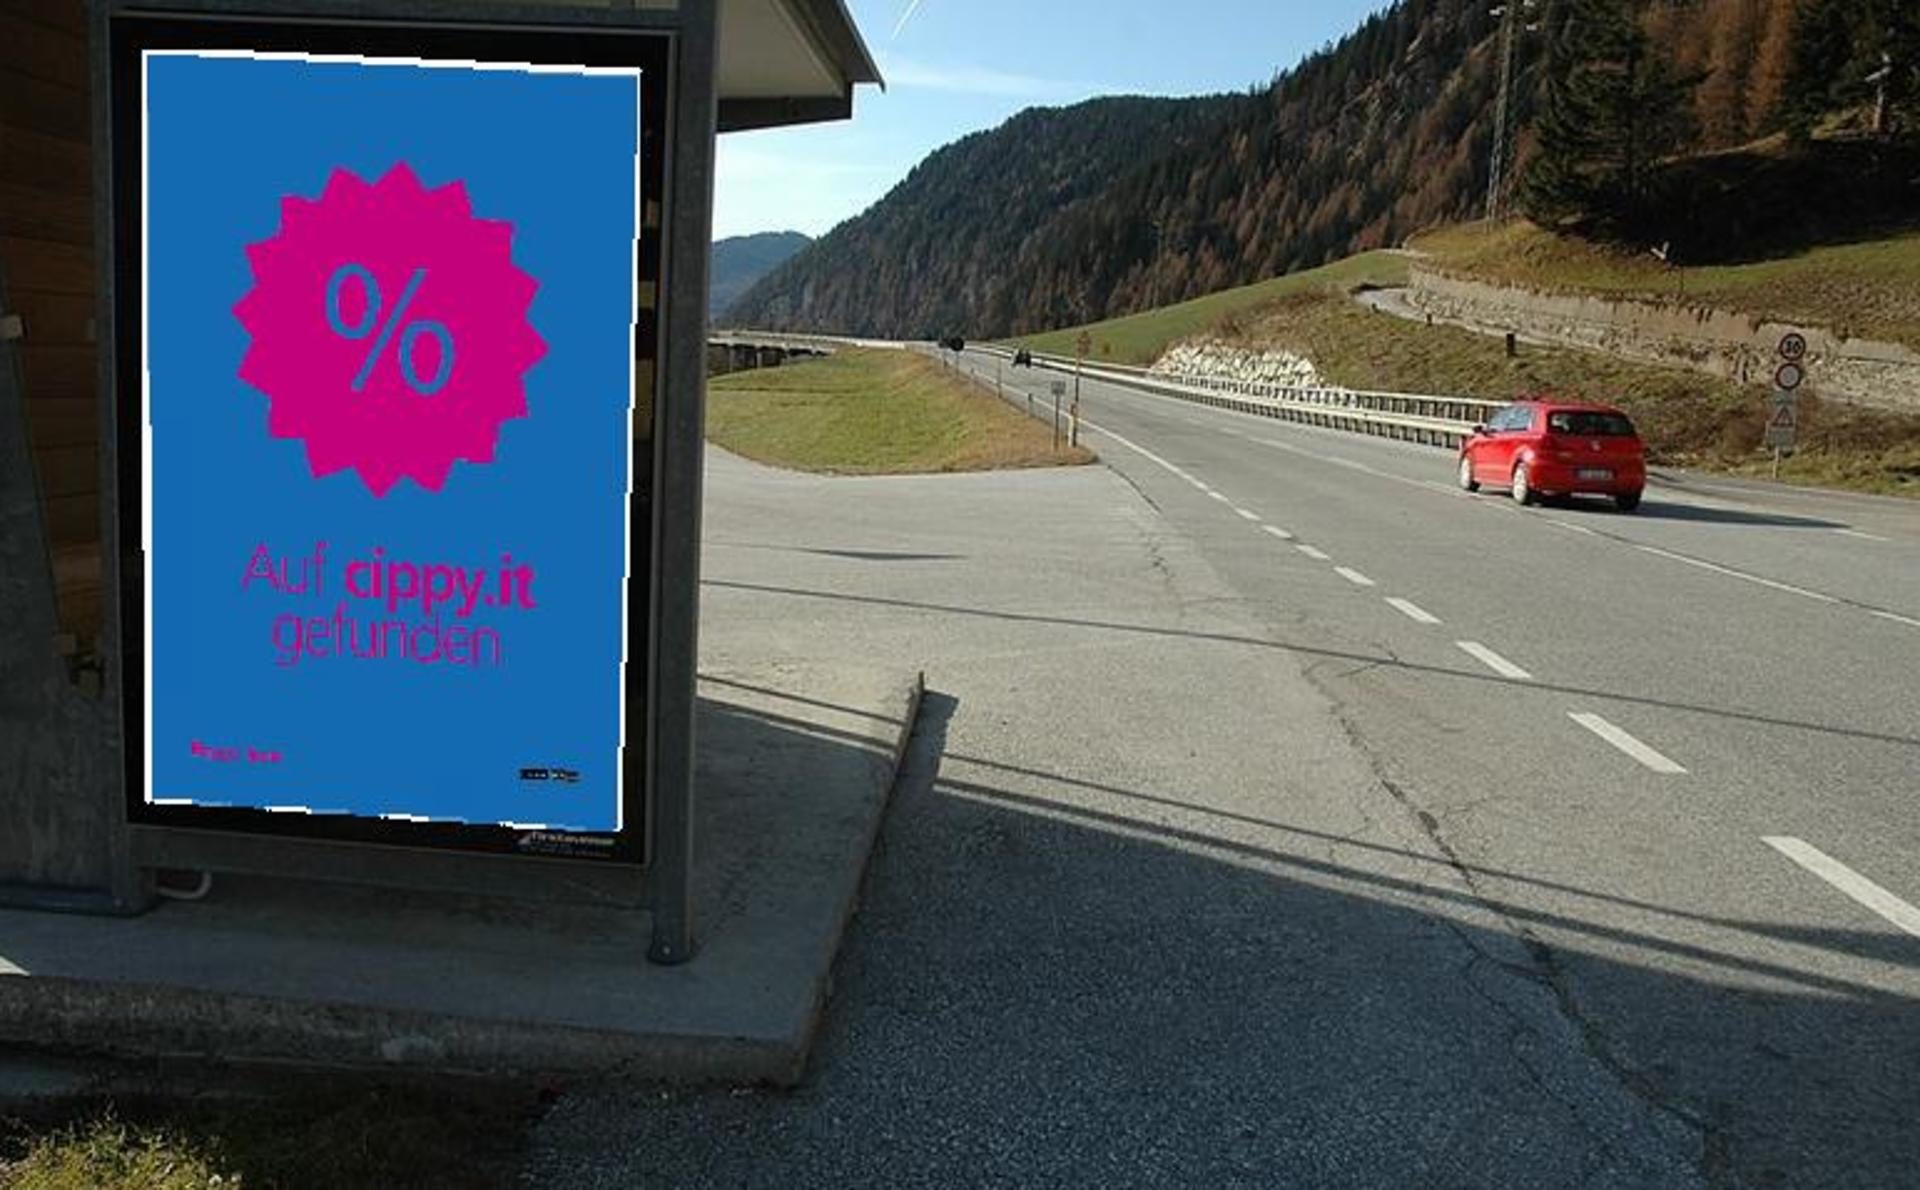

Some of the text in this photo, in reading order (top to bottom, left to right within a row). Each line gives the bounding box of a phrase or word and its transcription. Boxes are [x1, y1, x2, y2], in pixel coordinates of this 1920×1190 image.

[325, 263, 455, 394] %
[241, 542, 537, 617] Auf cippy.it
[272, 601, 502, 666] gefunden
